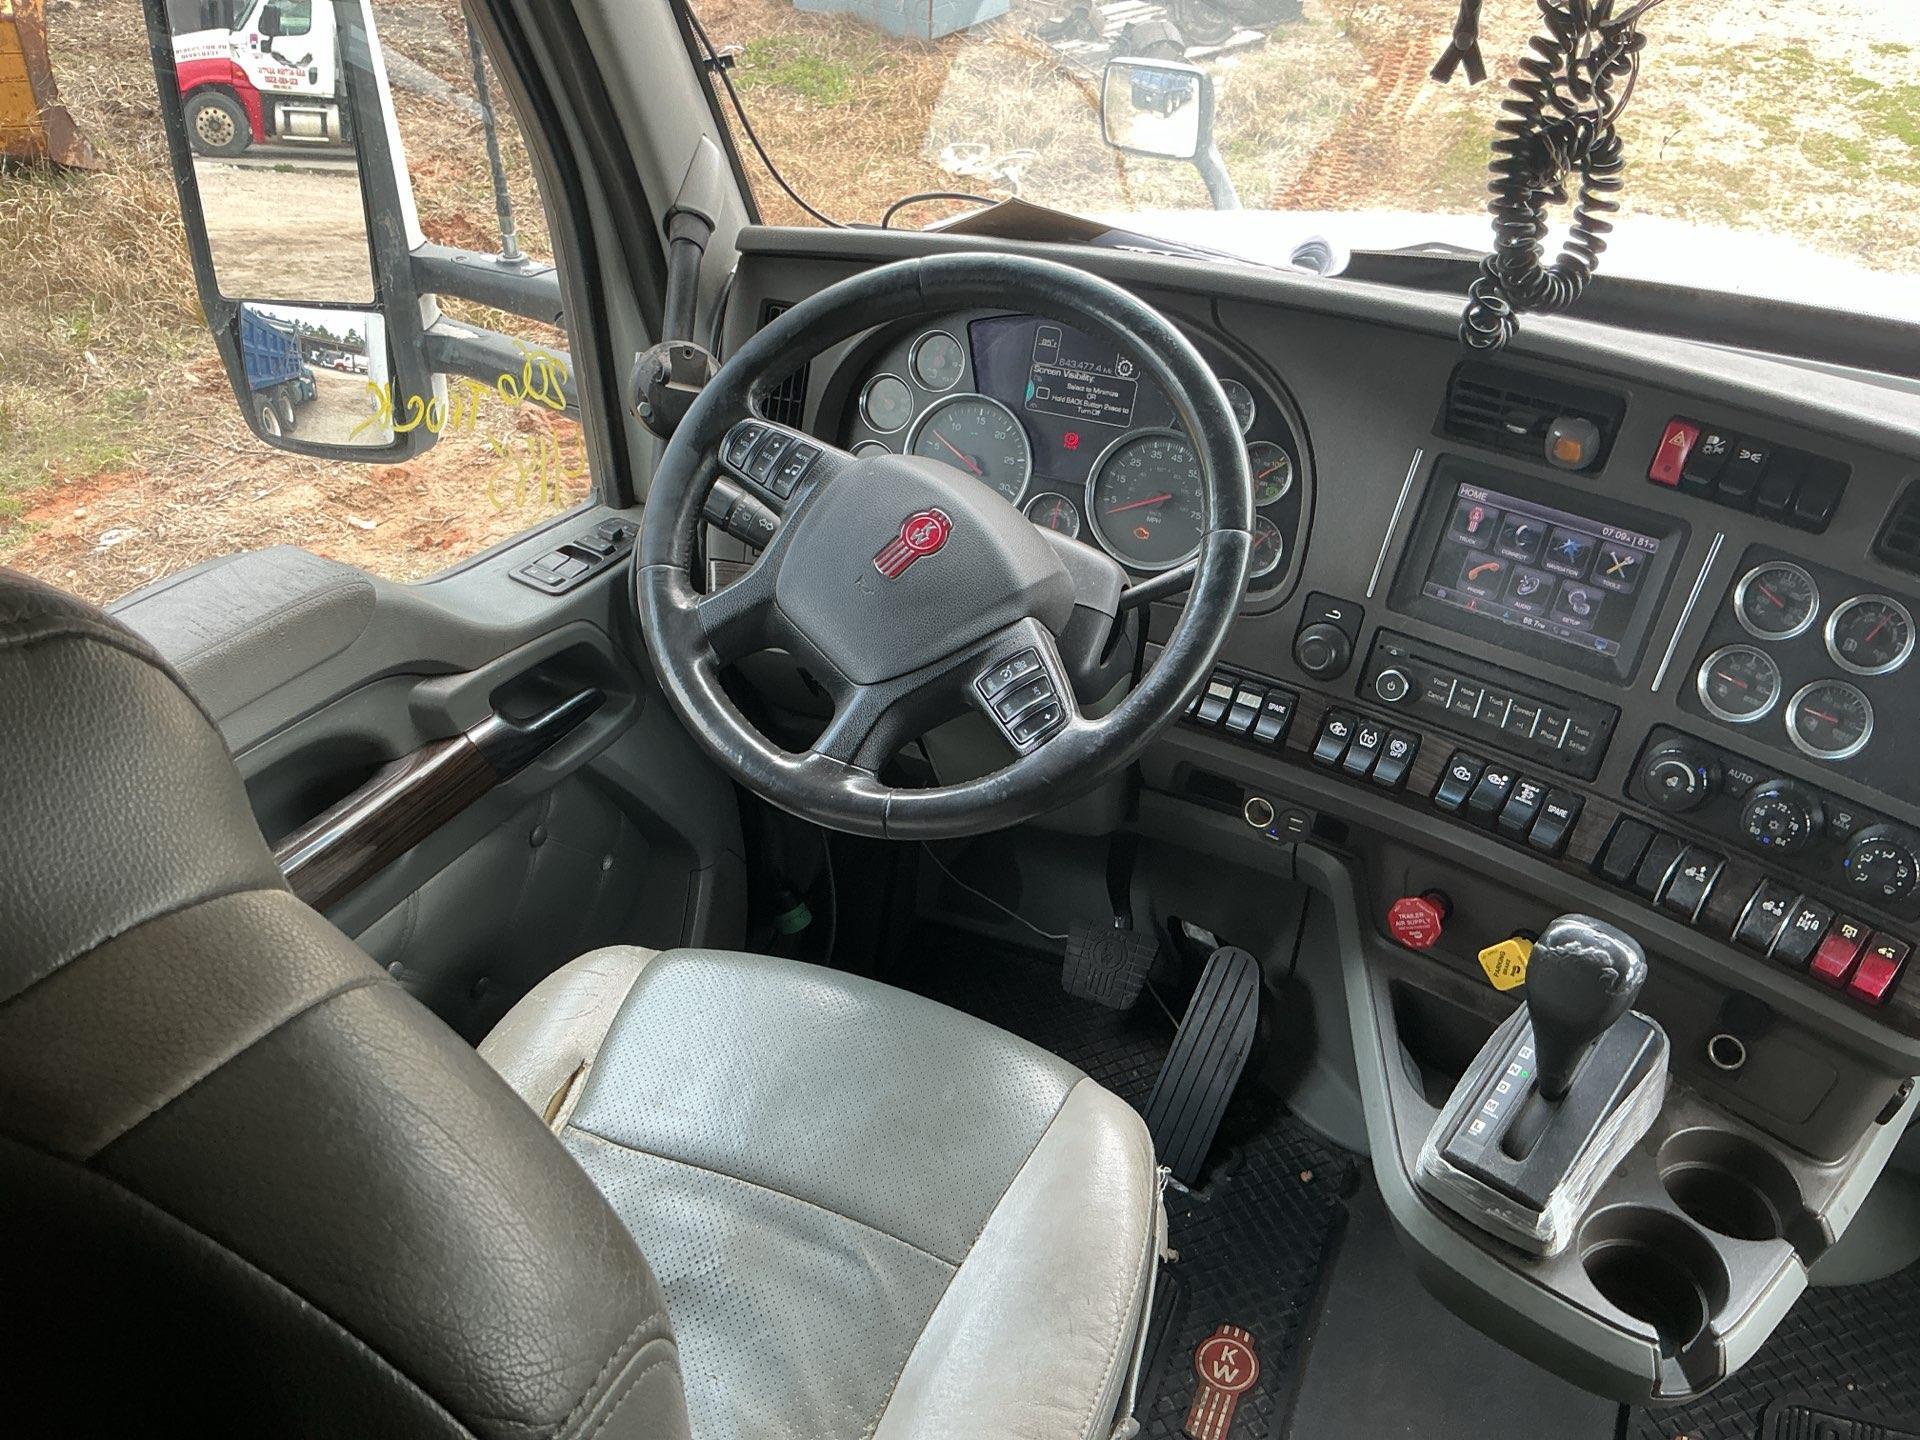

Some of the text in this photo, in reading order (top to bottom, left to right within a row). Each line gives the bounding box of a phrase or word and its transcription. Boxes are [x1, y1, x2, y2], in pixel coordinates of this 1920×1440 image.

[1033, 365, 1061, 377] Screen
[975, 416, 986, 426] 15
[951, 422, 962, 431] 10
[994, 430, 1006, 440] 20
[1003, 455, 1015, 465] 25
[1150, 450, 1163, 460] 35
[1170, 453, 1183, 463] 45
[1129, 458, 1142, 467] 25
[1116, 474, 1126, 484] 15
[998, 482, 1011, 492] 30
[1460, 486, 1488, 501] HOME
[1146, 515, 1162, 525] MPH
[1190, 510, 1202, 520] 75
[1459, 535, 1476, 545] TRUCK
[1501, 548, 1527, 561] CONNECT
[1546, 562, 1579, 577] NAVIGATION
[1514, 601, 1532, 611] AUDIO
[1562, 616, 1581, 627] SETUP
[1427, 690, 1445, 702] Cancel
[1267, 701, 1287, 714] SPARE
[1456, 700, 1471, 711] Audio
[1512, 704, 1535, 718] Connect
[1362, 734, 1375, 745] TC
[1389, 750, 1402, 759] OFF
[1727, 768, 1754, 785] AUTO
[1547, 804, 1569, 819] SPARE
[1777, 802, 1788, 813] 72
[1398, 911, 1424, 920] TRAILER
[1395, 918, 1431, 927] AIR SUPPLY
[1493, 950, 1506, 978] PARKING
